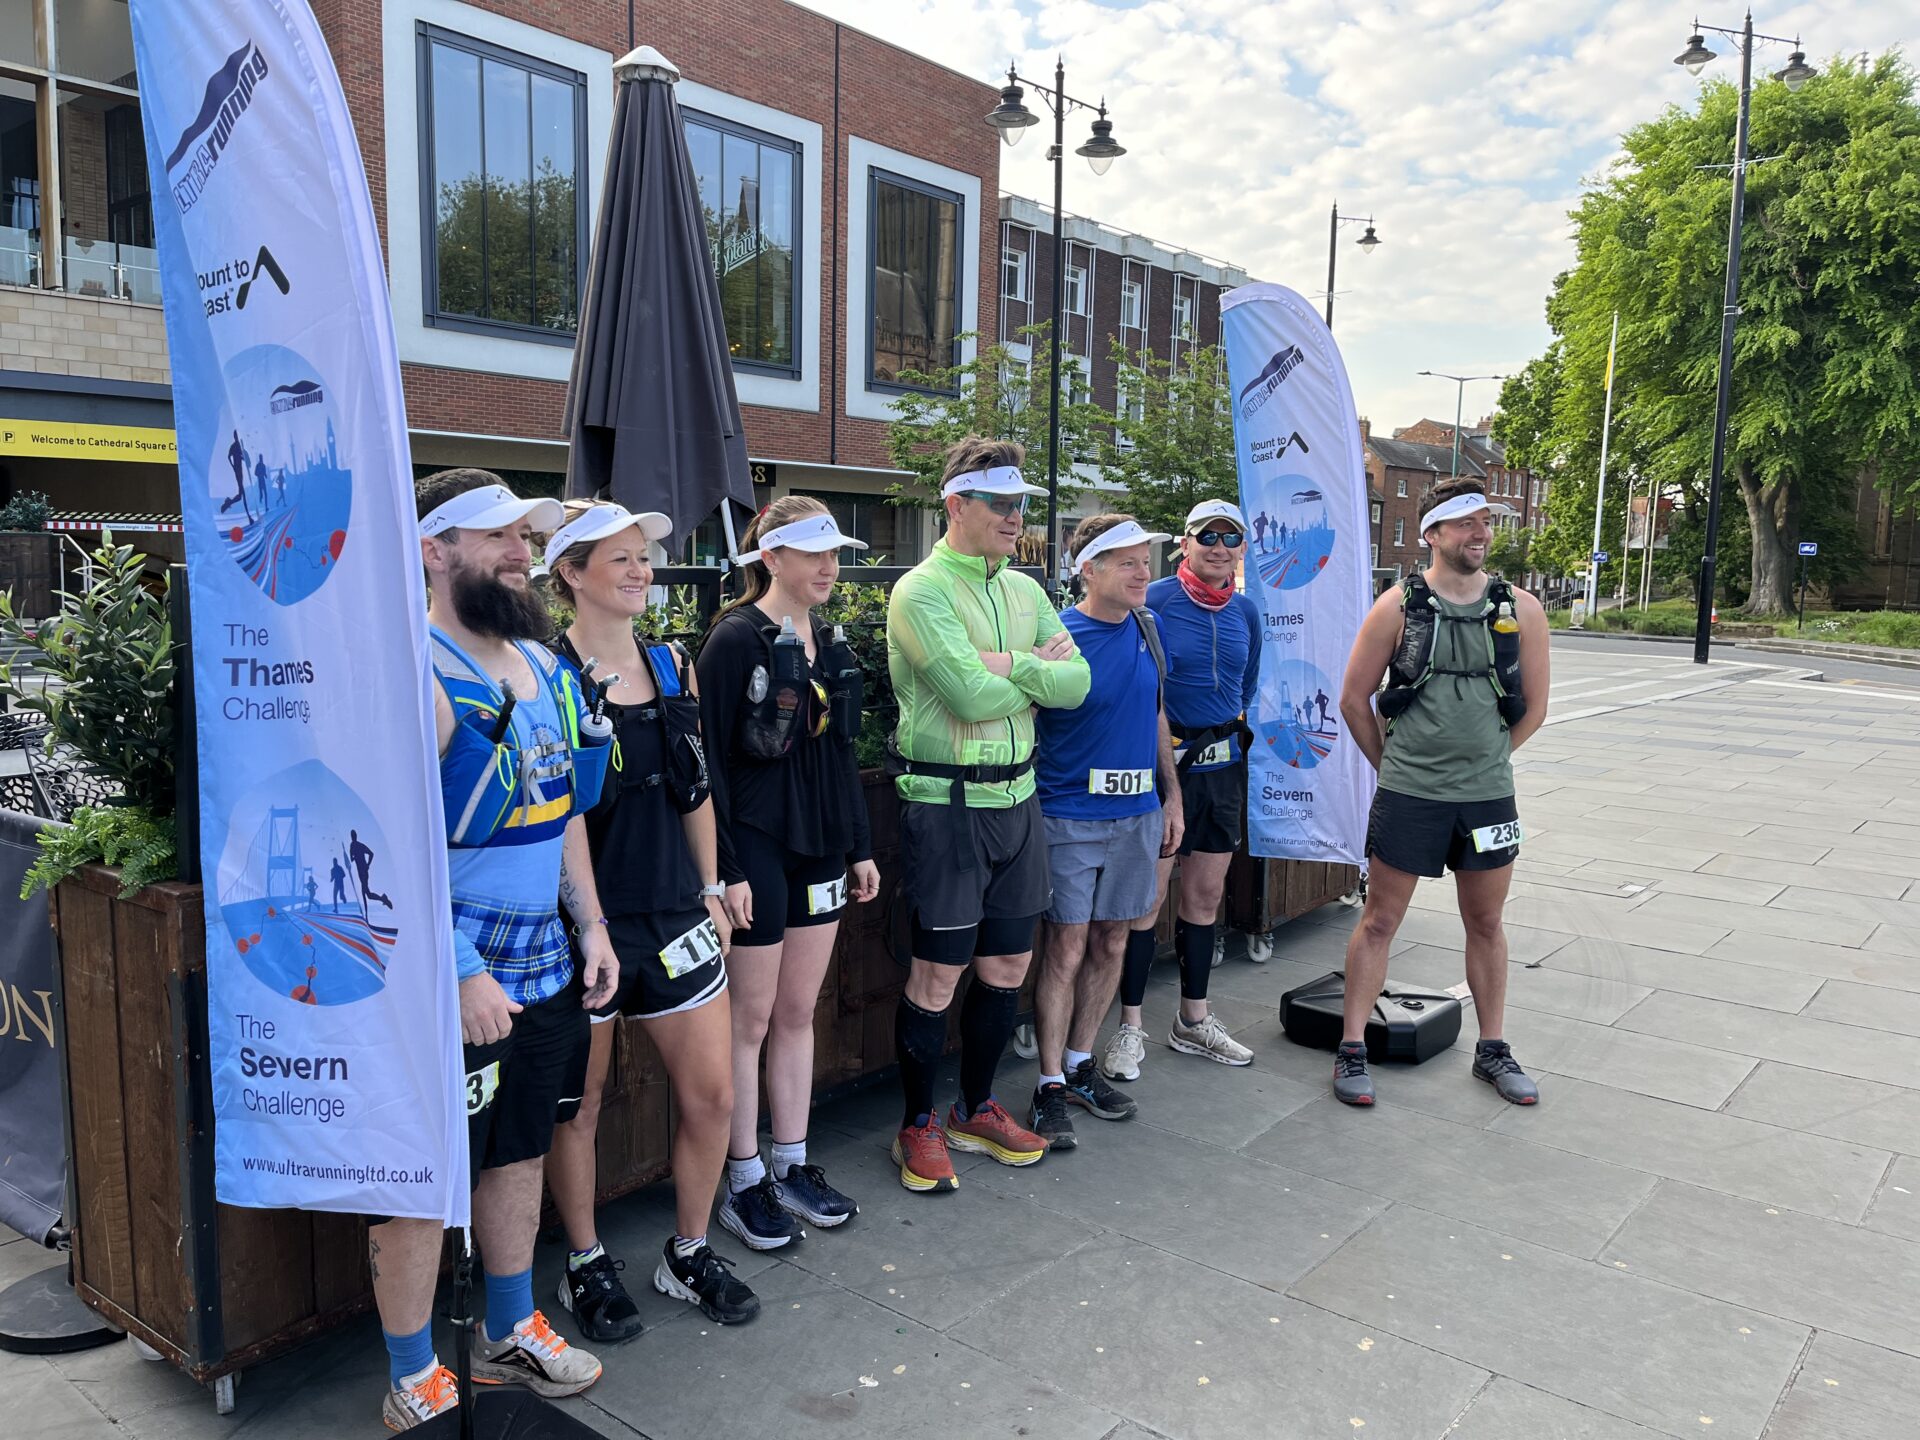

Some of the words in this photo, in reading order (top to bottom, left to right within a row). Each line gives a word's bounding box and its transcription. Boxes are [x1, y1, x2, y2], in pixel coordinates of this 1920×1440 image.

[196, 263, 232, 290] ount
[234, 259, 250, 279] to
[31, 434, 74, 446] Welcome
[76, 438, 86, 446] to
[88, 437, 133, 449] Cathedral
[135, 440, 167, 451] Square
[1250, 438, 1275, 452] Mount
[1277, 436, 1287, 446] to
[1251, 450, 1274, 464] Coast
[223, 624, 269, 646] The
[222, 658, 314, 686] Thames
[1190, 746, 1217, 765] 04
[1104, 771, 1142, 794] 501
[1264, 771, 1284, 783] The
[1262, 786, 1313, 802] Severn
[1262, 805, 1313, 820] Challenge
[1490, 821, 1520, 845] 236
[236, 1015, 275, 1039] The
[240, 1047, 348, 1080] Severn
[243, 1088, 345, 1123] Challenge
[243, 1157, 434, 1184] www.ultrarunningltd.co.uk
